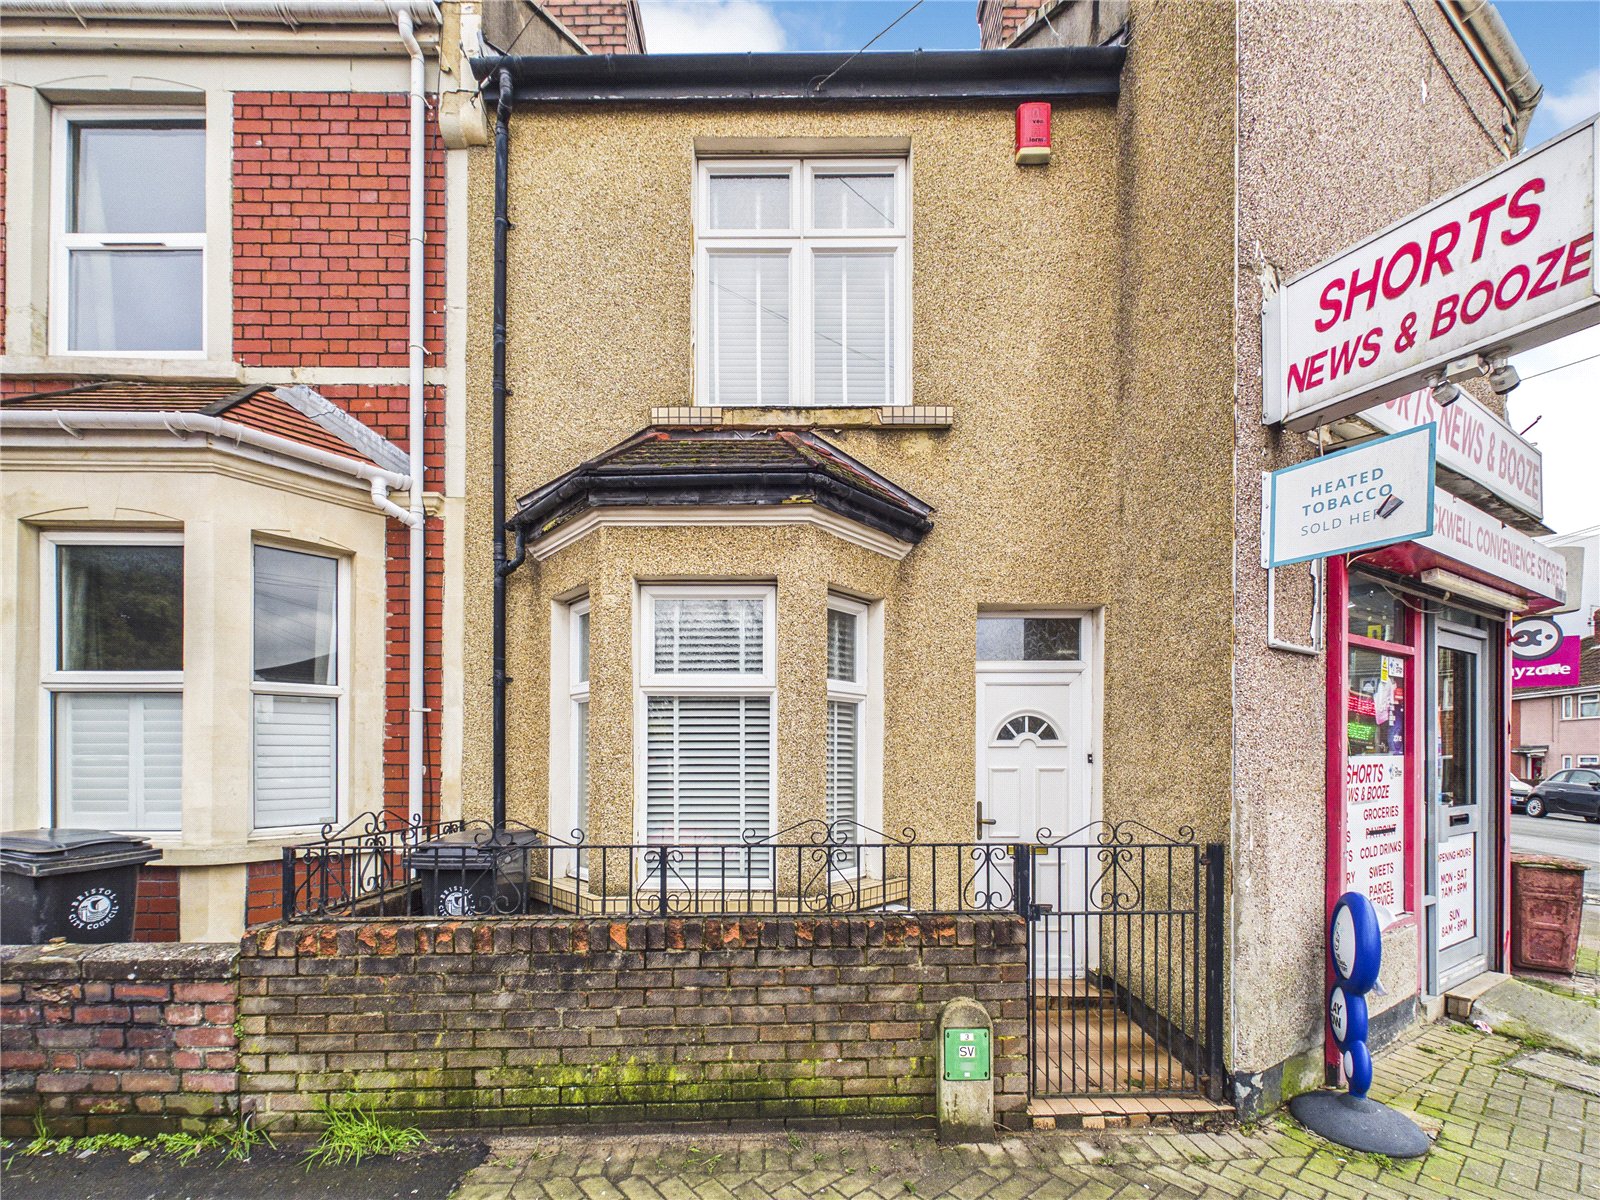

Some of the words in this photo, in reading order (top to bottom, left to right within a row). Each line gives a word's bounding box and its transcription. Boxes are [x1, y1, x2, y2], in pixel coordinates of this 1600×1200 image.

[1315, 178, 1545, 332] SHORTS
[1287, 327, 1383, 397] NEWS
[1394, 312, 1417, 353] &
[1430, 232, 1594, 340] BOOZE
[1385, 388, 1437, 426] RTS
[1438, 403, 1484, 465] NEWS
[1487, 432, 1495, 472] &
[1498, 440, 1539, 501] BOOZE
[1311, 468, 1384, 497] HEATED
[1302, 484, 1393, 516] TOBACCO
[1301, 518, 1342, 536] SOLD
[1476, 526, 1536, 577] CONVENIENCE
[1538, 557, 1564, 587] STORES
[1347, 763, 1384, 785] SHORTS
[1347, 787, 1360, 802] WS
[1367, 785, 1390, 800] BOOZE
[1363, 805, 1399, 821] GROCERIES
[1360, 845, 1378, 859] COLD
[1380, 841, 1402, 856] DRINKS
[1438, 851, 1456, 862] PENING
[1457, 848, 1472, 858] HOURS
[1369, 862, 1394, 879] SWEETS
[1440, 872, 1453, 885] MON
[1457, 868, 1468, 880] SAT
[71, 887, 117, 907] BRISTOL
[1369, 881, 1394, 897] PARCEL
[1370, 893, 1394, 906] RVICE
[68, 914, 85, 929] CITY
[86, 905, 119, 930] COUNCIL
[1449, 908, 1460, 922] SUN
[959, 1046, 975, 1057] SV
